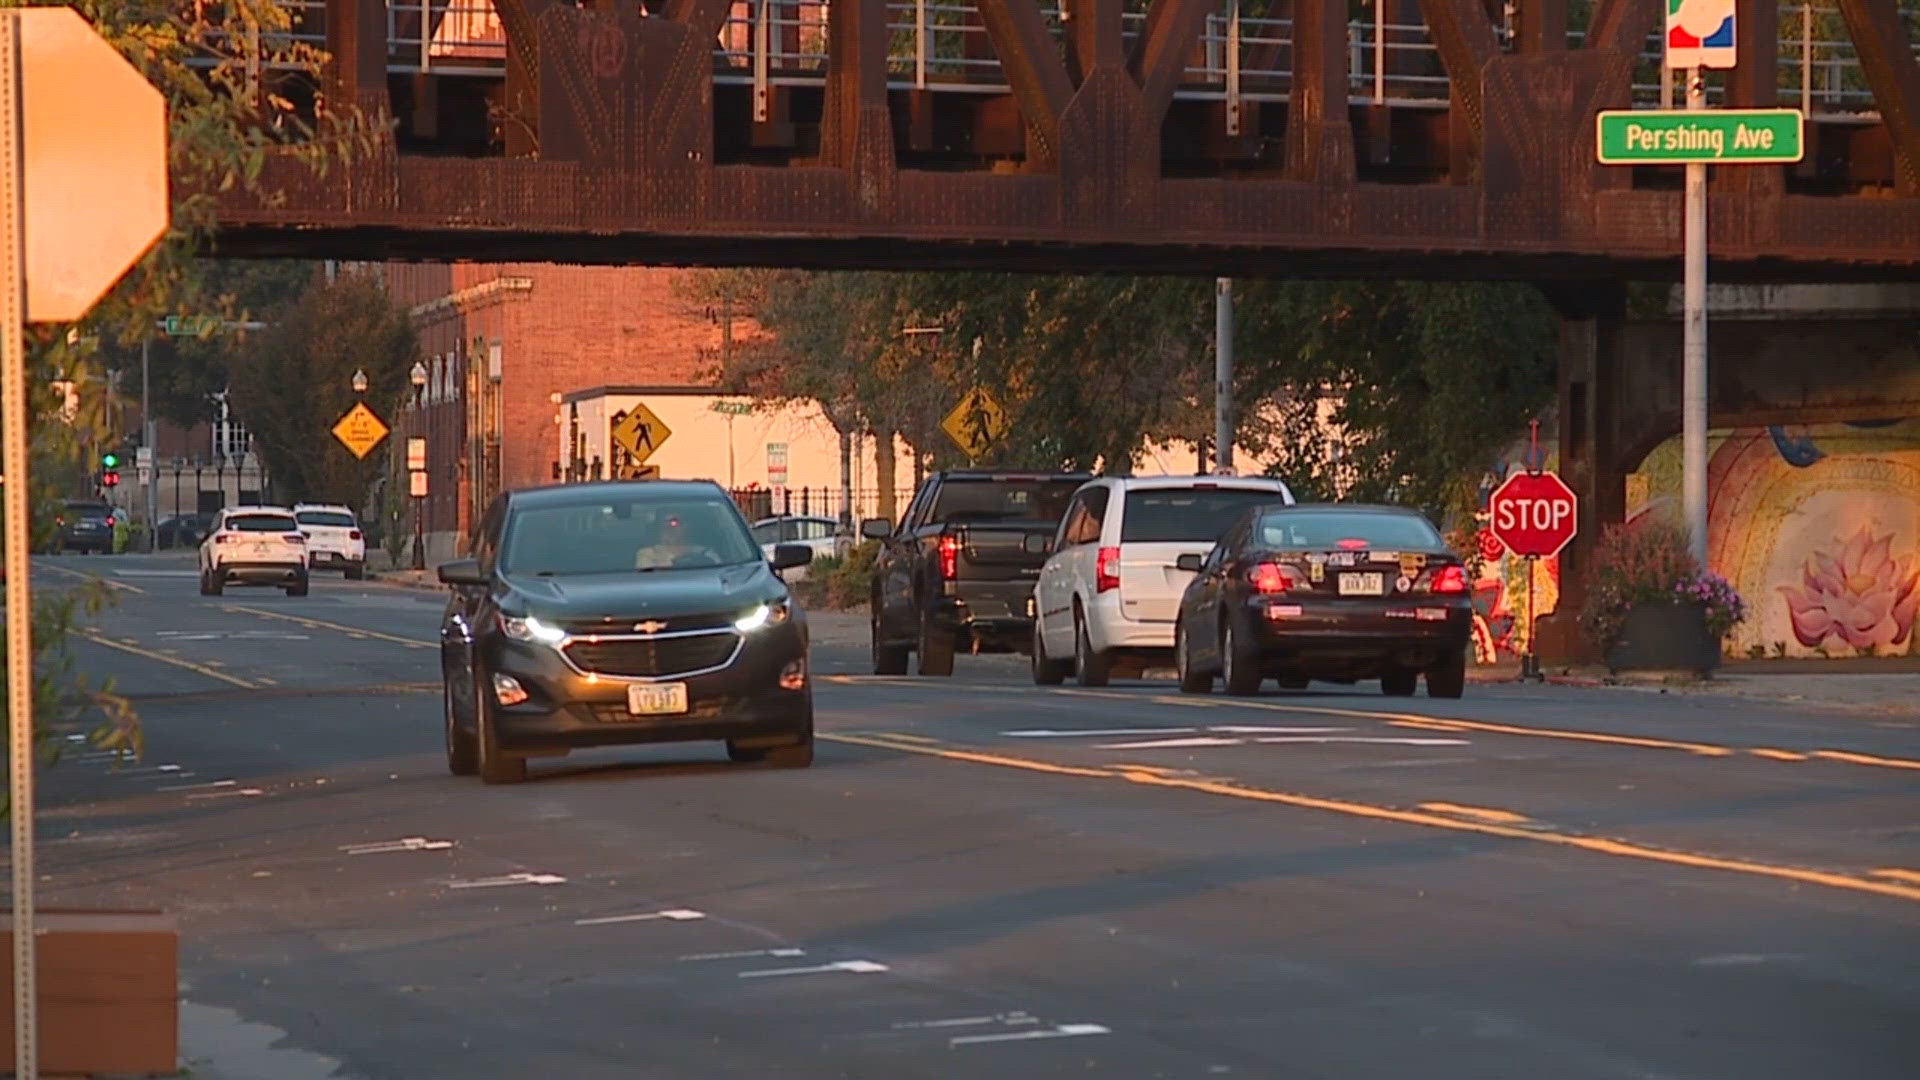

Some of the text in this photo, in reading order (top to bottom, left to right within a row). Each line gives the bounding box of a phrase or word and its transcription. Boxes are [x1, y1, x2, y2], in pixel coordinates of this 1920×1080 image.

[1626, 123, 1774, 157] Pershing Ave
[1497, 498, 1571, 532] STOP
